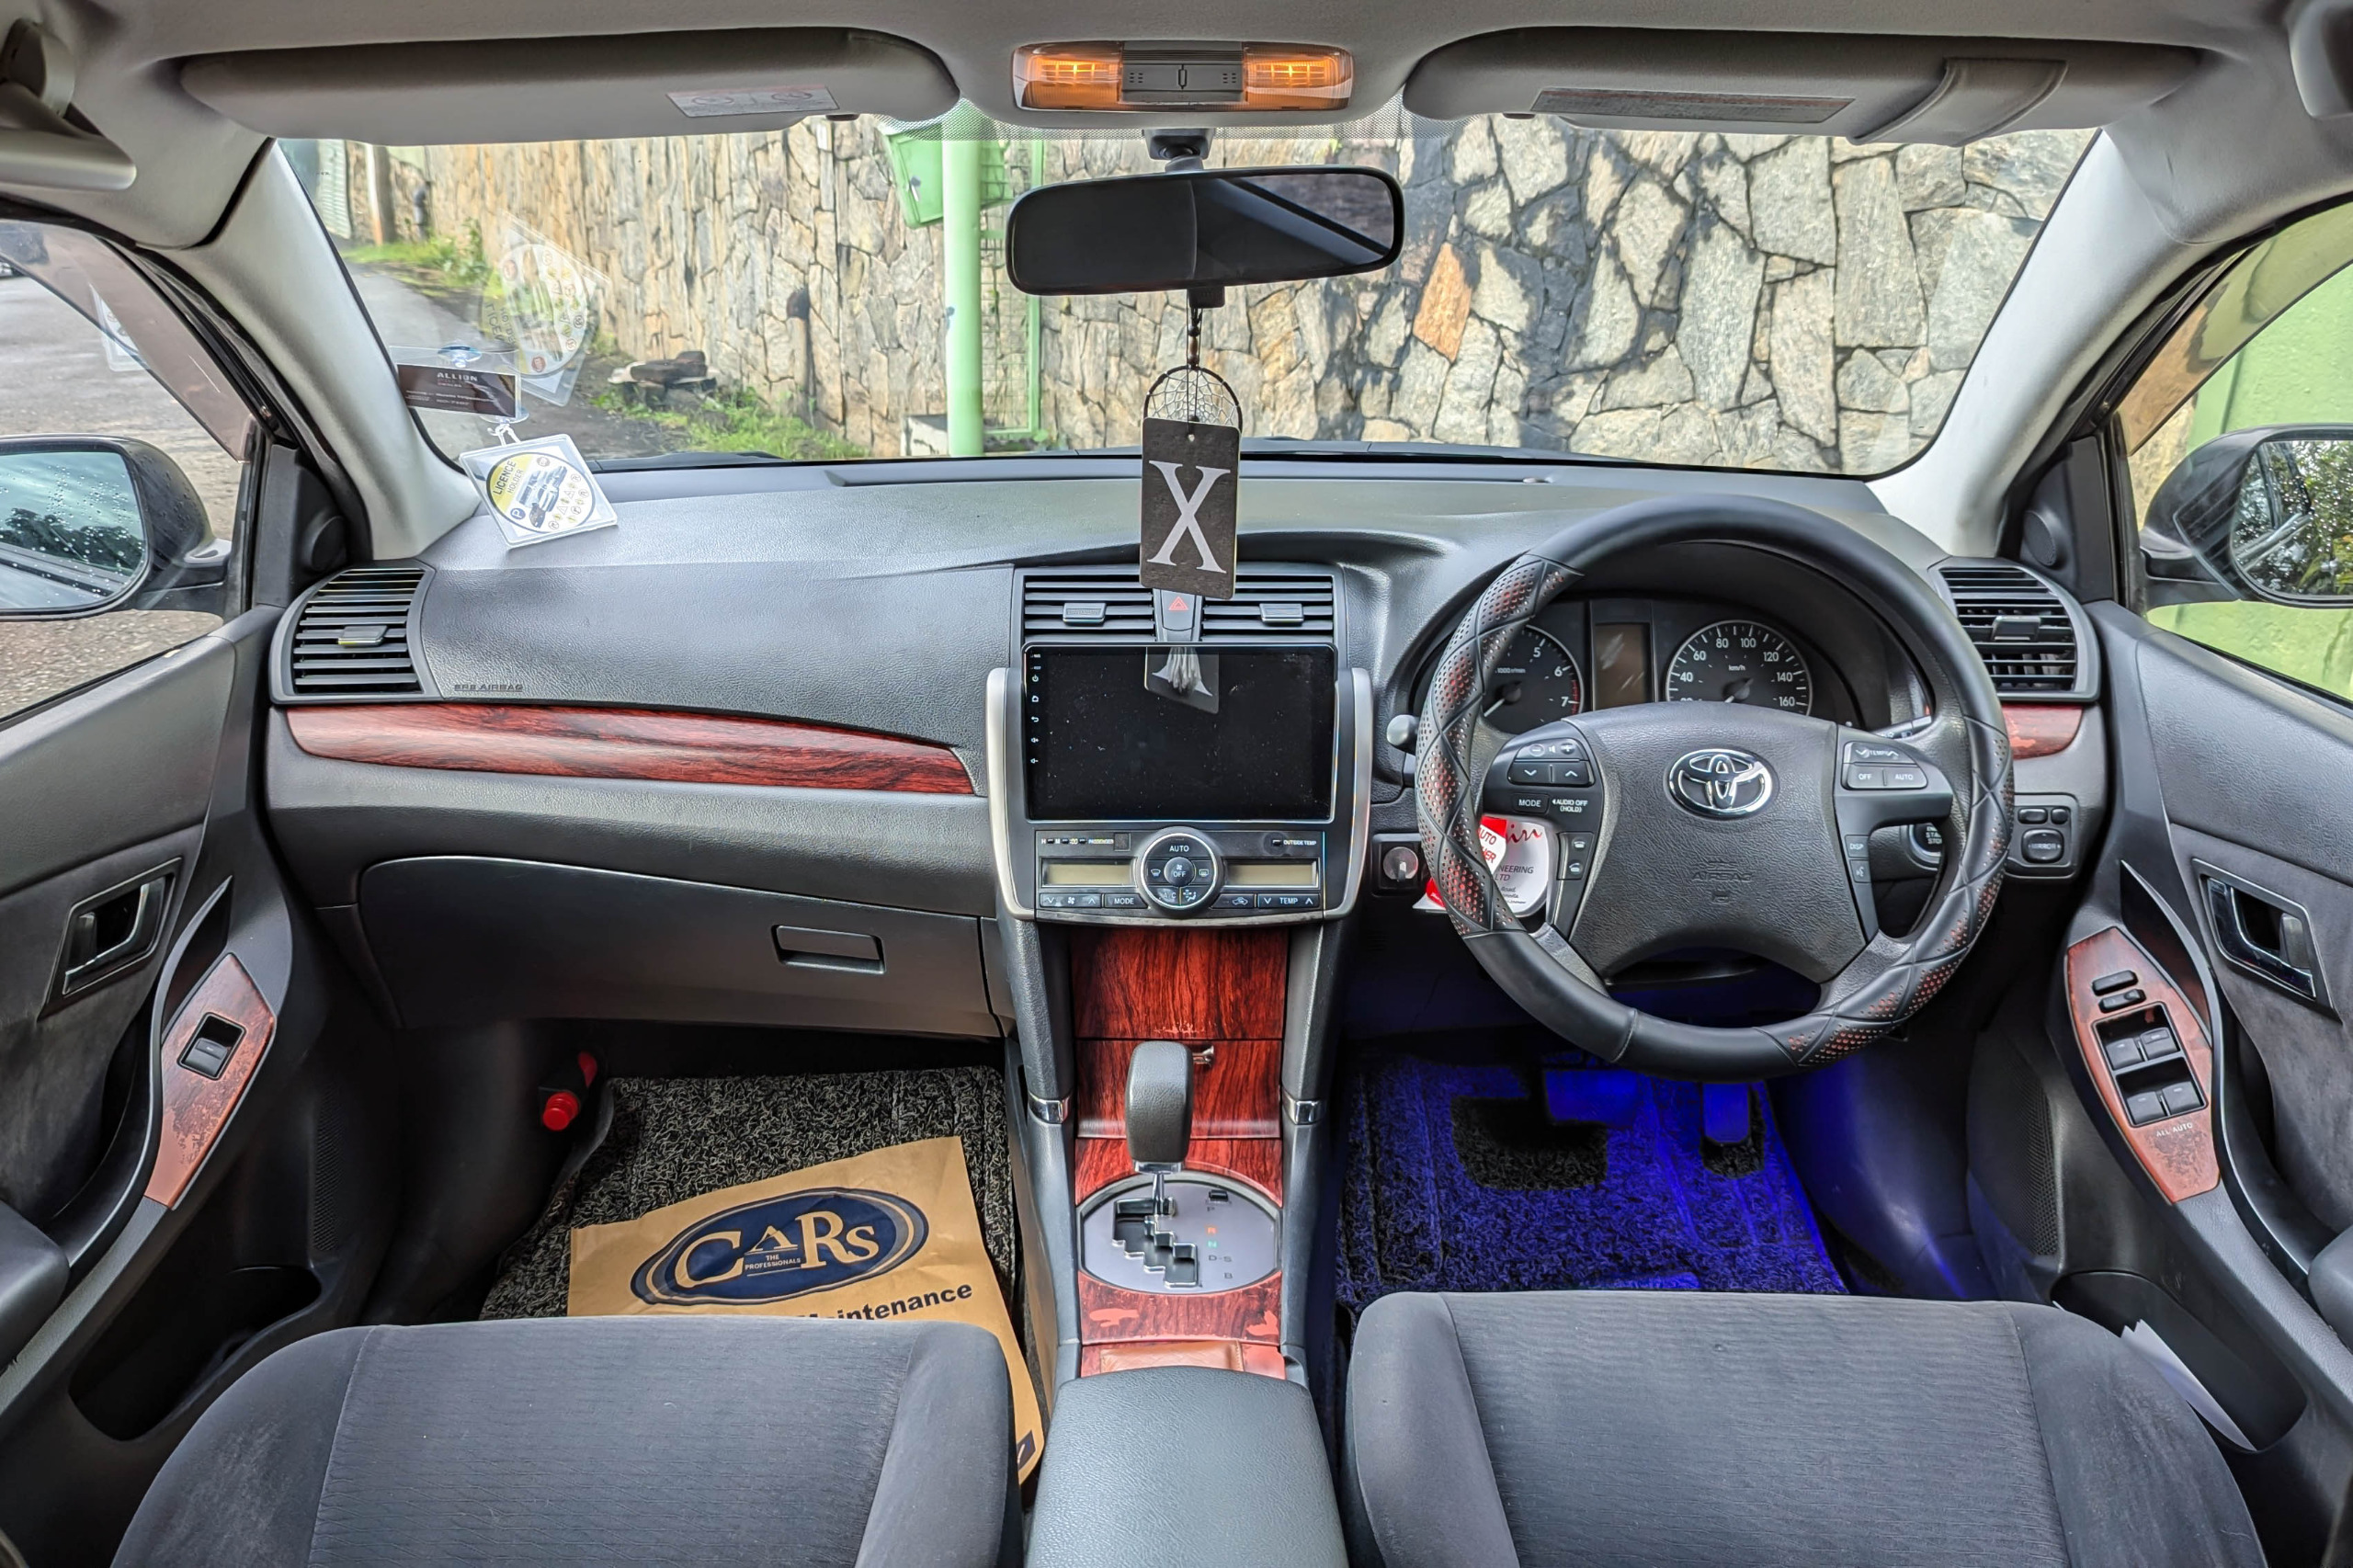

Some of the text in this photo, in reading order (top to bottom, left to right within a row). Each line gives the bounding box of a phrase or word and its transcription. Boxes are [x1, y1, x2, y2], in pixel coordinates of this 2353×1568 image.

[493, 460, 517, 495] LICENCE
[507, 468, 524, 494] HOLDER
[1146, 460, 1231, 574] X
[1715, 637, 1729, 649] 80
[1740, 637, 1756, 649] 100
[1532, 647, 1541, 658] 5
[1692, 650, 1707, 661] 60
[1763, 651, 1779, 662] 120
[1553, 665, 1563, 677] 6
[1728, 664, 1746, 672] km/h
[1679, 671, 1694, 682] 40
[1776, 672, 1792, 682] 140
[1561, 696, 1569, 707] 7
[1779, 696, 1795, 707] 160
[1518, 798, 1541, 807] MODE
[1169, 845, 1189, 853] AUTO
[1173, 870, 1186, 879] OFF
[1114, 897, 1134, 905] MODE
[1279, 897, 1299, 905] TEMP
[2172, 1121, 2194, 1133] AUTO
[765, 1253, 780, 1261] THE
[745, 1256, 801, 1270] PROFESSIONALS
[798, 1283, 973, 1321] intenance
